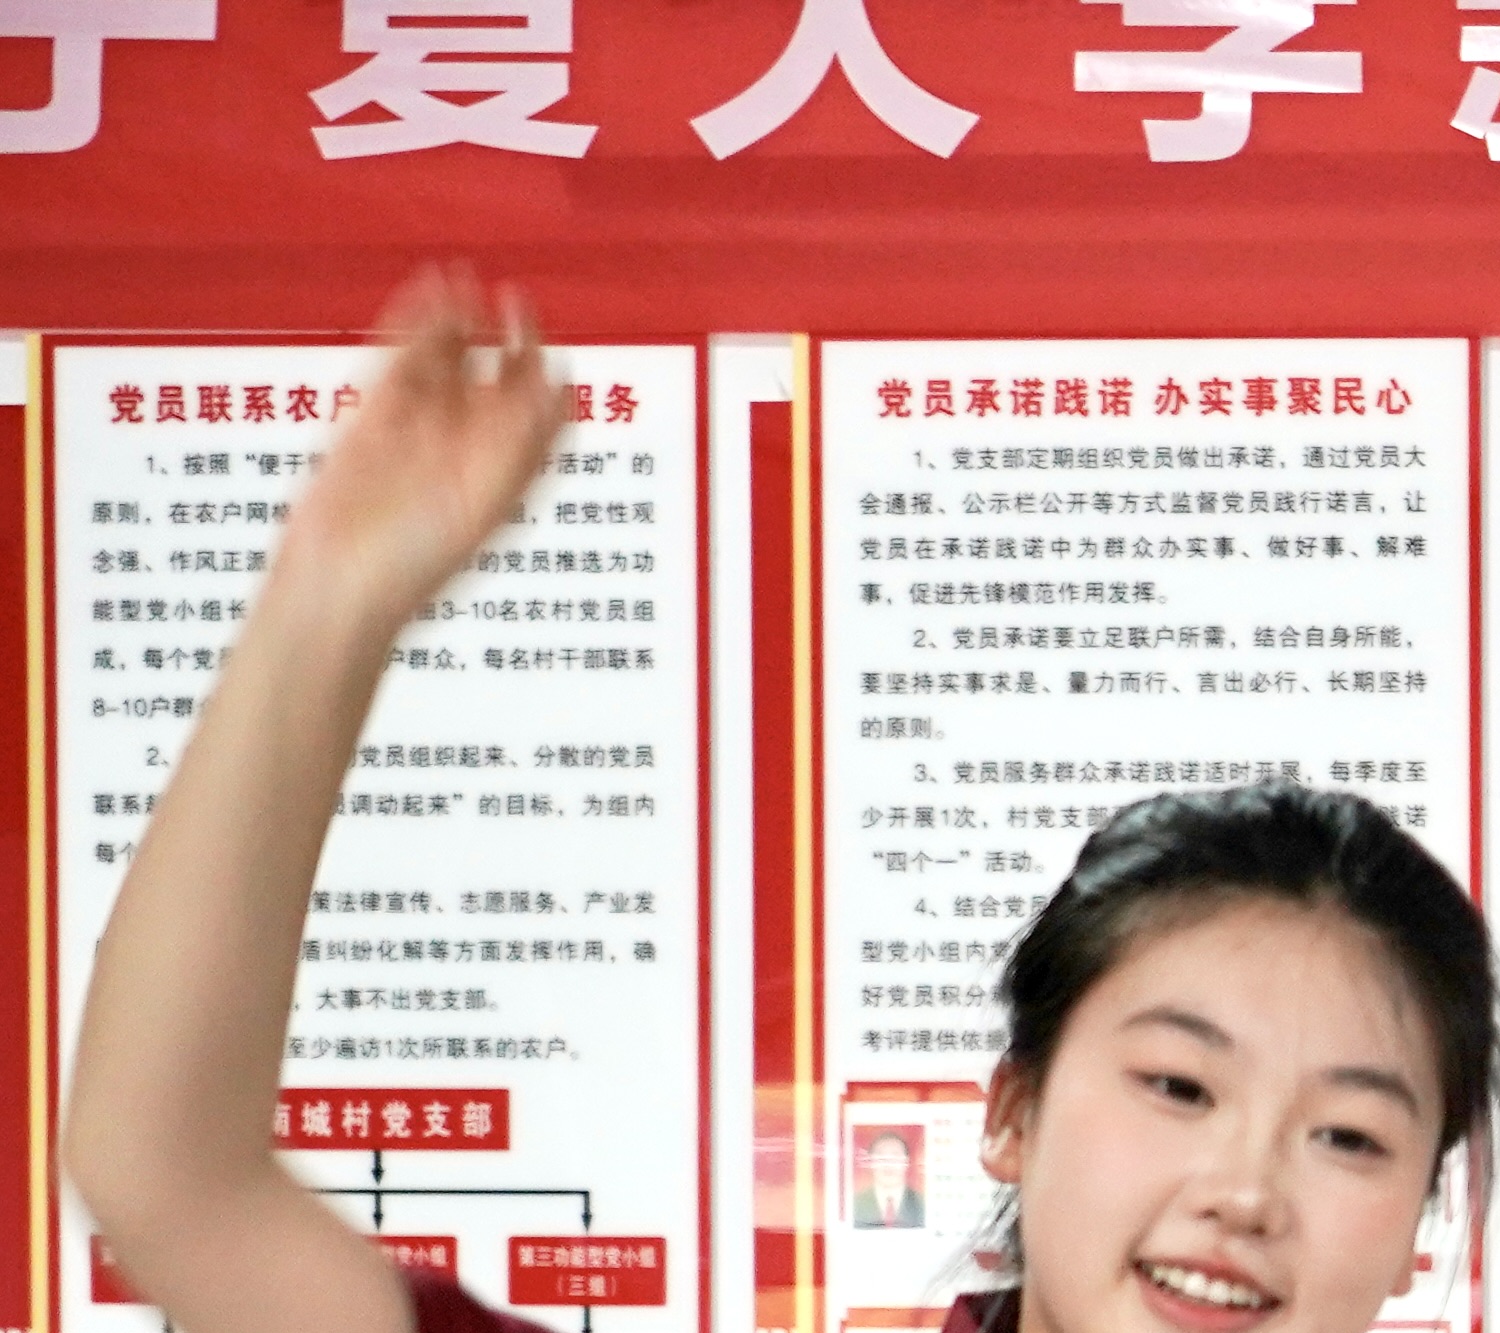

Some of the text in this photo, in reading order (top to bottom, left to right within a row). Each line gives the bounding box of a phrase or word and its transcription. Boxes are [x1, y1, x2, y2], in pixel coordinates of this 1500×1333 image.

[109, 384, 360, 424] 党员联系农户
[877, 377, 1412, 418] 党员承诺践诺 办实事聚民心
[541, 453, 655, 476] 活动”的
[861, 717, 946, 738] 的原则。
[351, 746, 655, 769] 党员组织起来、分散的党员
